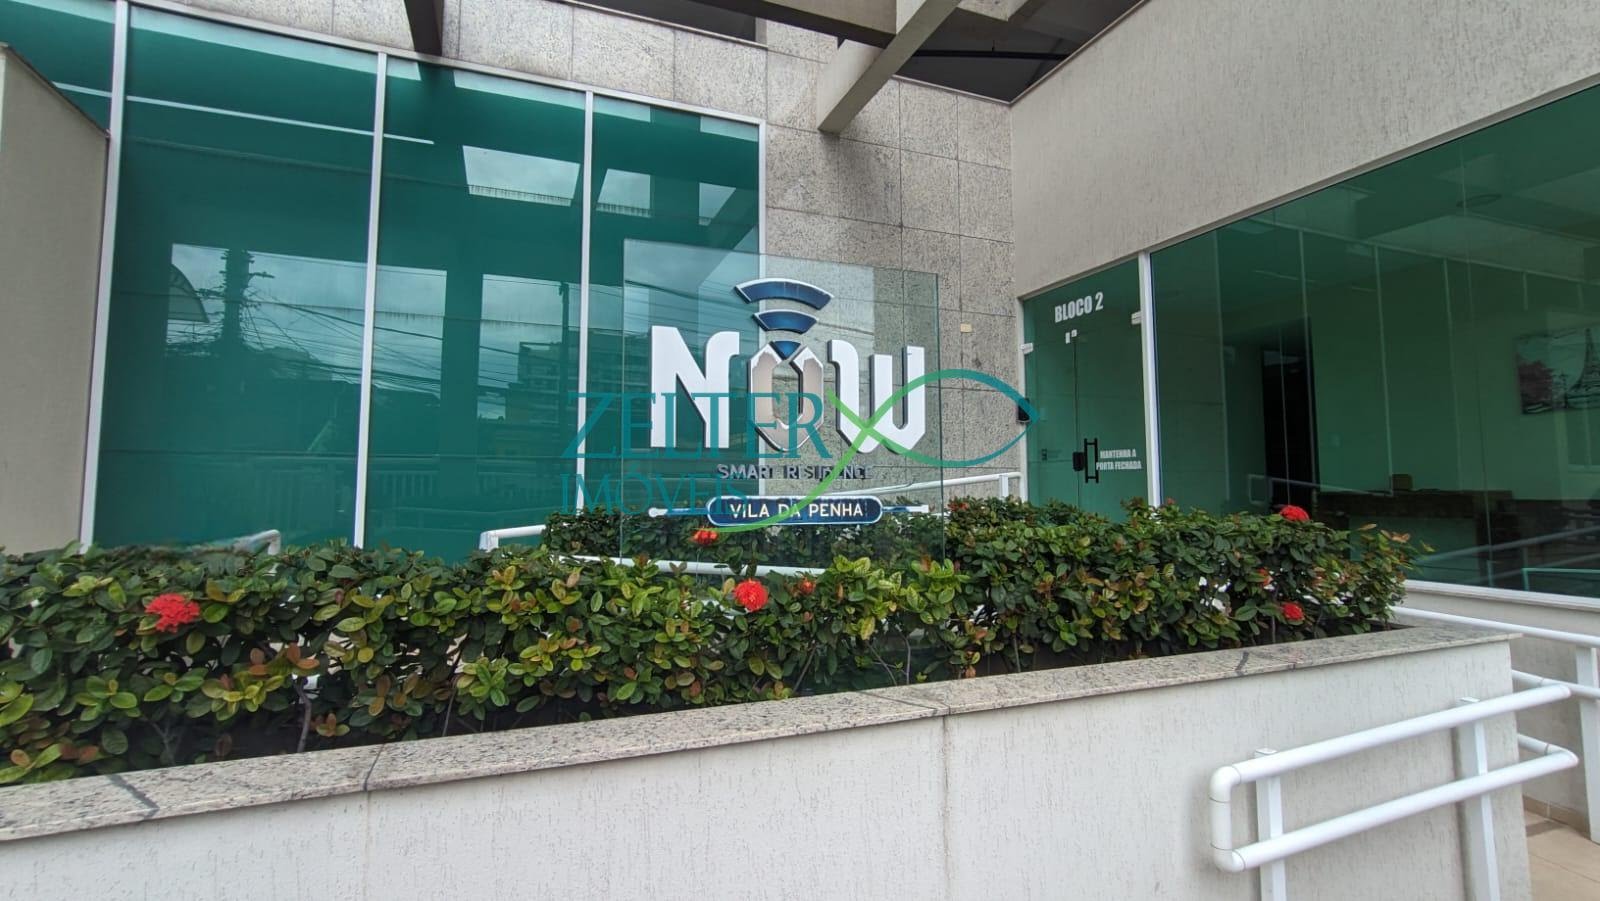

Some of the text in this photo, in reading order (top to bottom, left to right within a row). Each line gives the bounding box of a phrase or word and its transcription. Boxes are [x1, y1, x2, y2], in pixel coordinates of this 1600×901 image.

[1055, 291, 1104, 323] BLOCO 2
[650, 325, 926, 453] NOW
[1131, 448, 1137, 457] A
[716, 463, 874, 481] SMART RESIDNCE
[1096, 461, 1114, 470] PORTA
[730, 502, 864, 519] VILA DA PENHA
